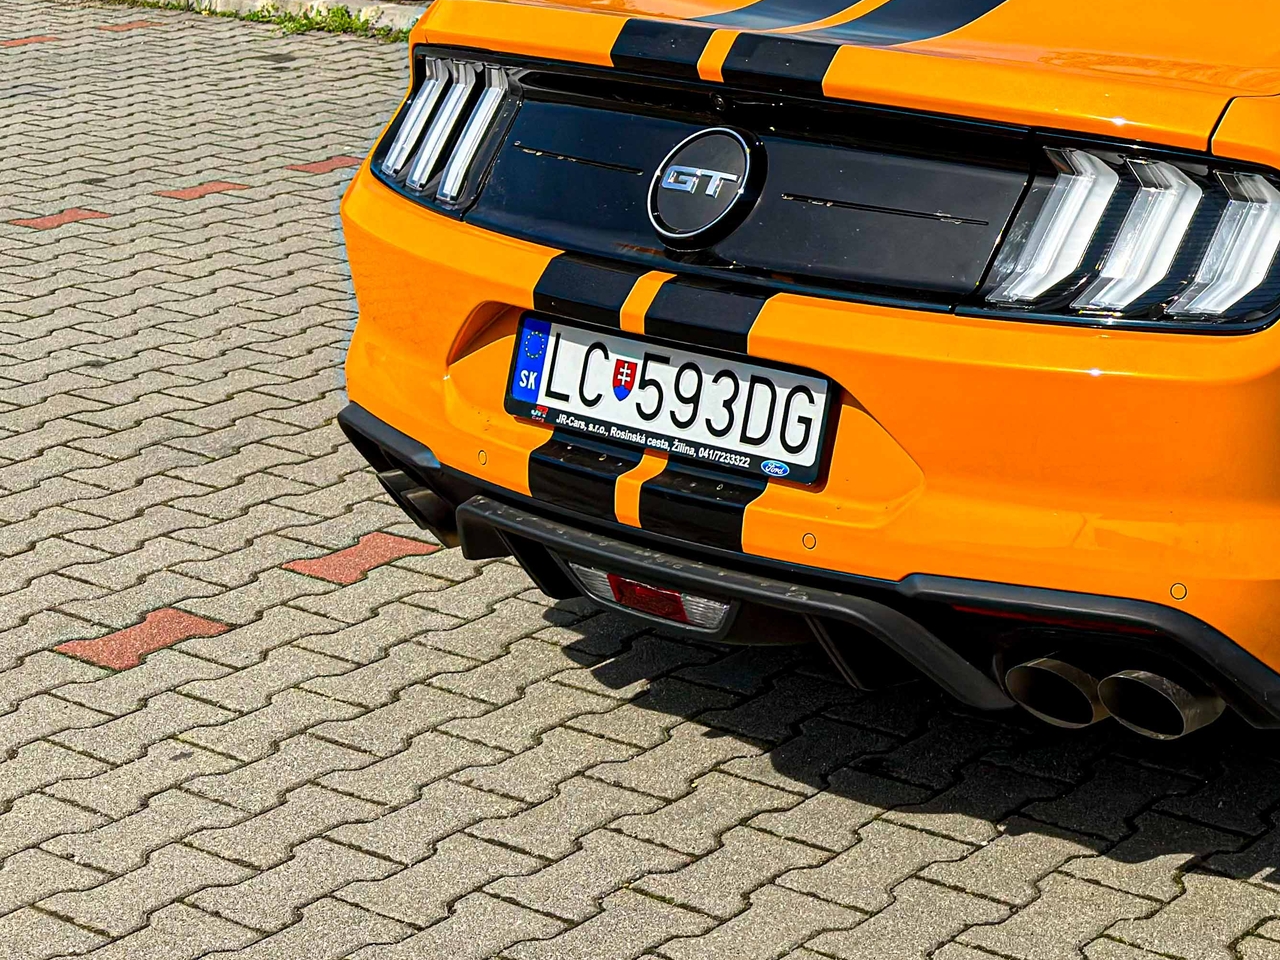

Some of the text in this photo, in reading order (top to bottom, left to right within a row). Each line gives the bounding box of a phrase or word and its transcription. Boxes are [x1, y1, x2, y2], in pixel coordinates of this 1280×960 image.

[661, 164, 741, 199] GT
[519, 369, 538, 390] SK
[545, 332, 816, 455] LC 593DG
[556, 413, 587, 431] JR-Cars,
[610, 426, 646, 445] Rosinská
[647, 436, 671, 451] cesta,
[698, 447, 751, 468] 041/7233322
[764, 462, 785, 475] Ford
